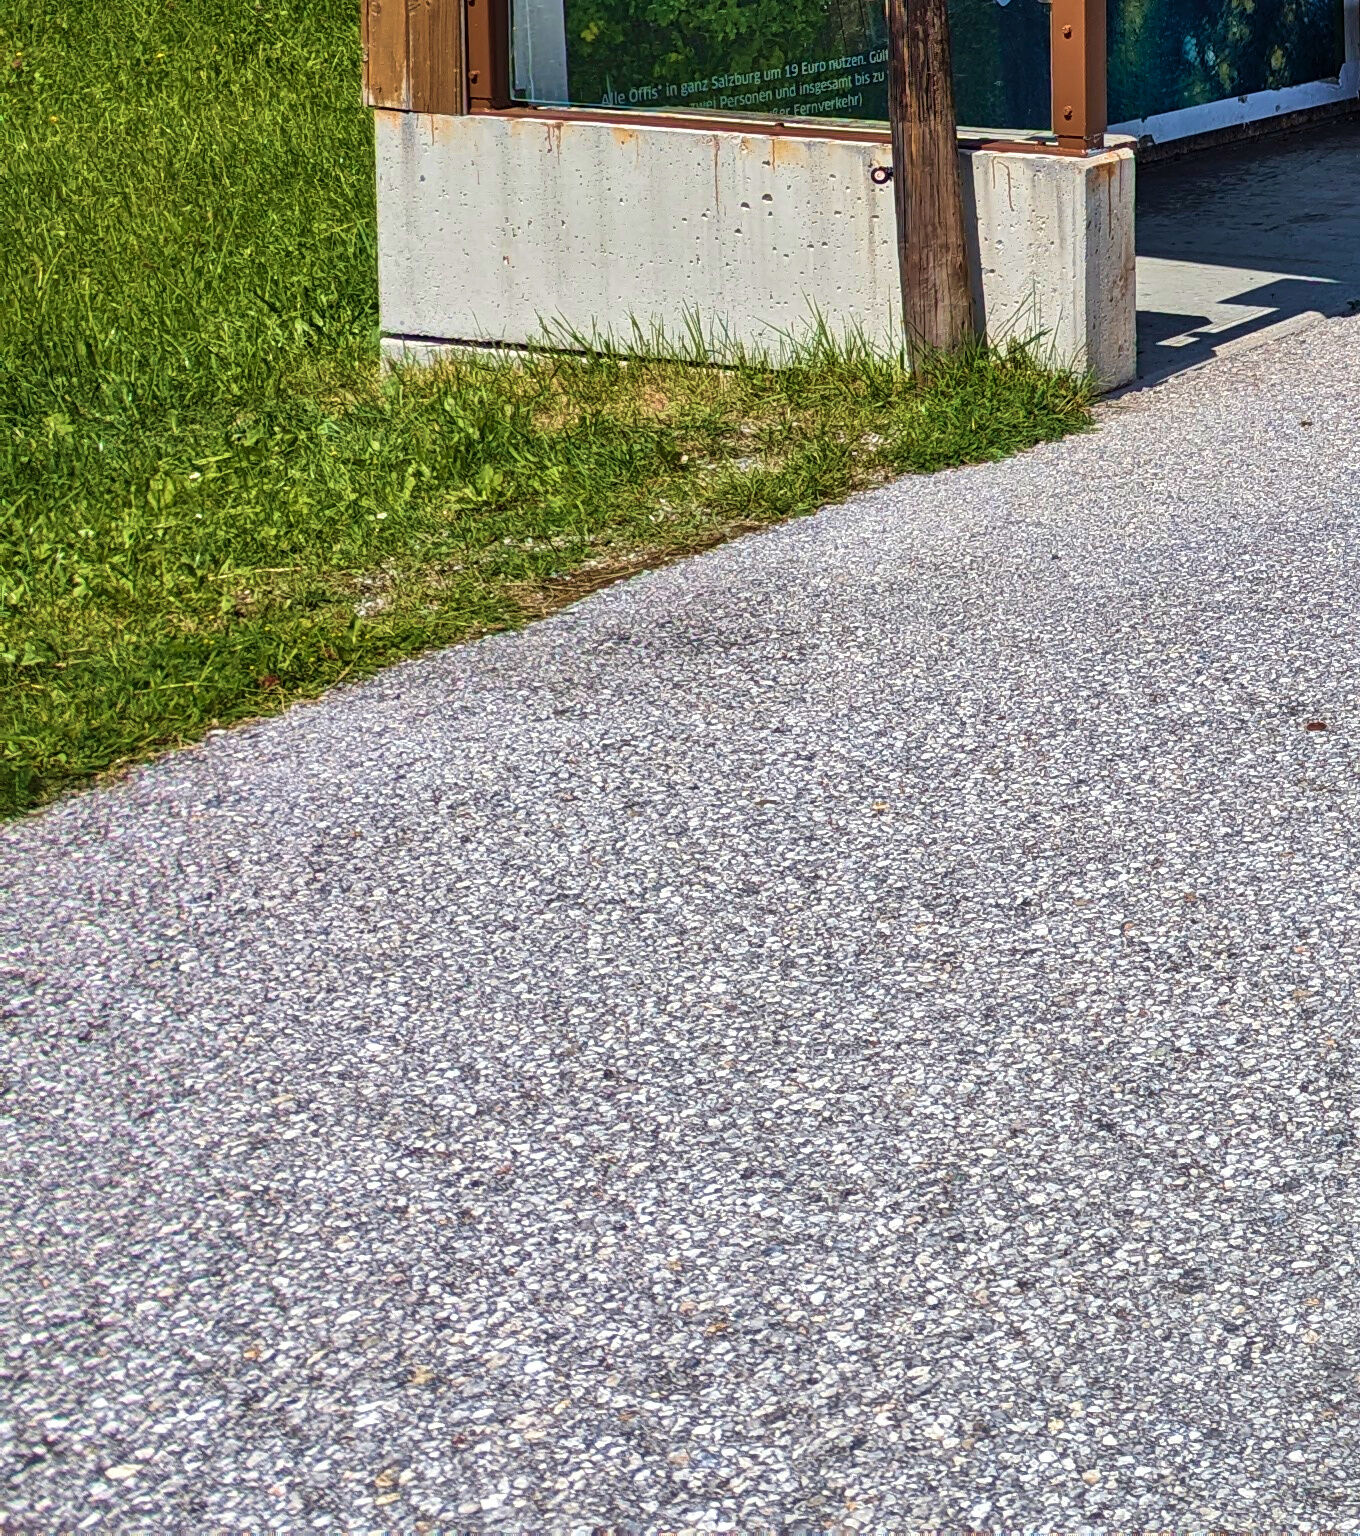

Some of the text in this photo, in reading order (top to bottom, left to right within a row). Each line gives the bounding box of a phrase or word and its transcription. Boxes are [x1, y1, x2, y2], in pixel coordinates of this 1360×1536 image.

[666, 82, 678, 97] in
[681, 79, 708, 97] ganz
[711, 71, 761, 90] Salzburg
[764, 68, 781, 81] um
[785, 64, 799, 78] 19
[801, 61, 826, 75] Euro
[829, 55, 866, 71] nutzen.
[720, 90, 773, 109] Personen
[775, 85, 796, 99] und
[799, 76, 853, 95] insgesamt
[855, 73, 870, 86] bis
[873, 72, 885, 82] zu
[794, 93, 863, 116] Fernverkehr)
